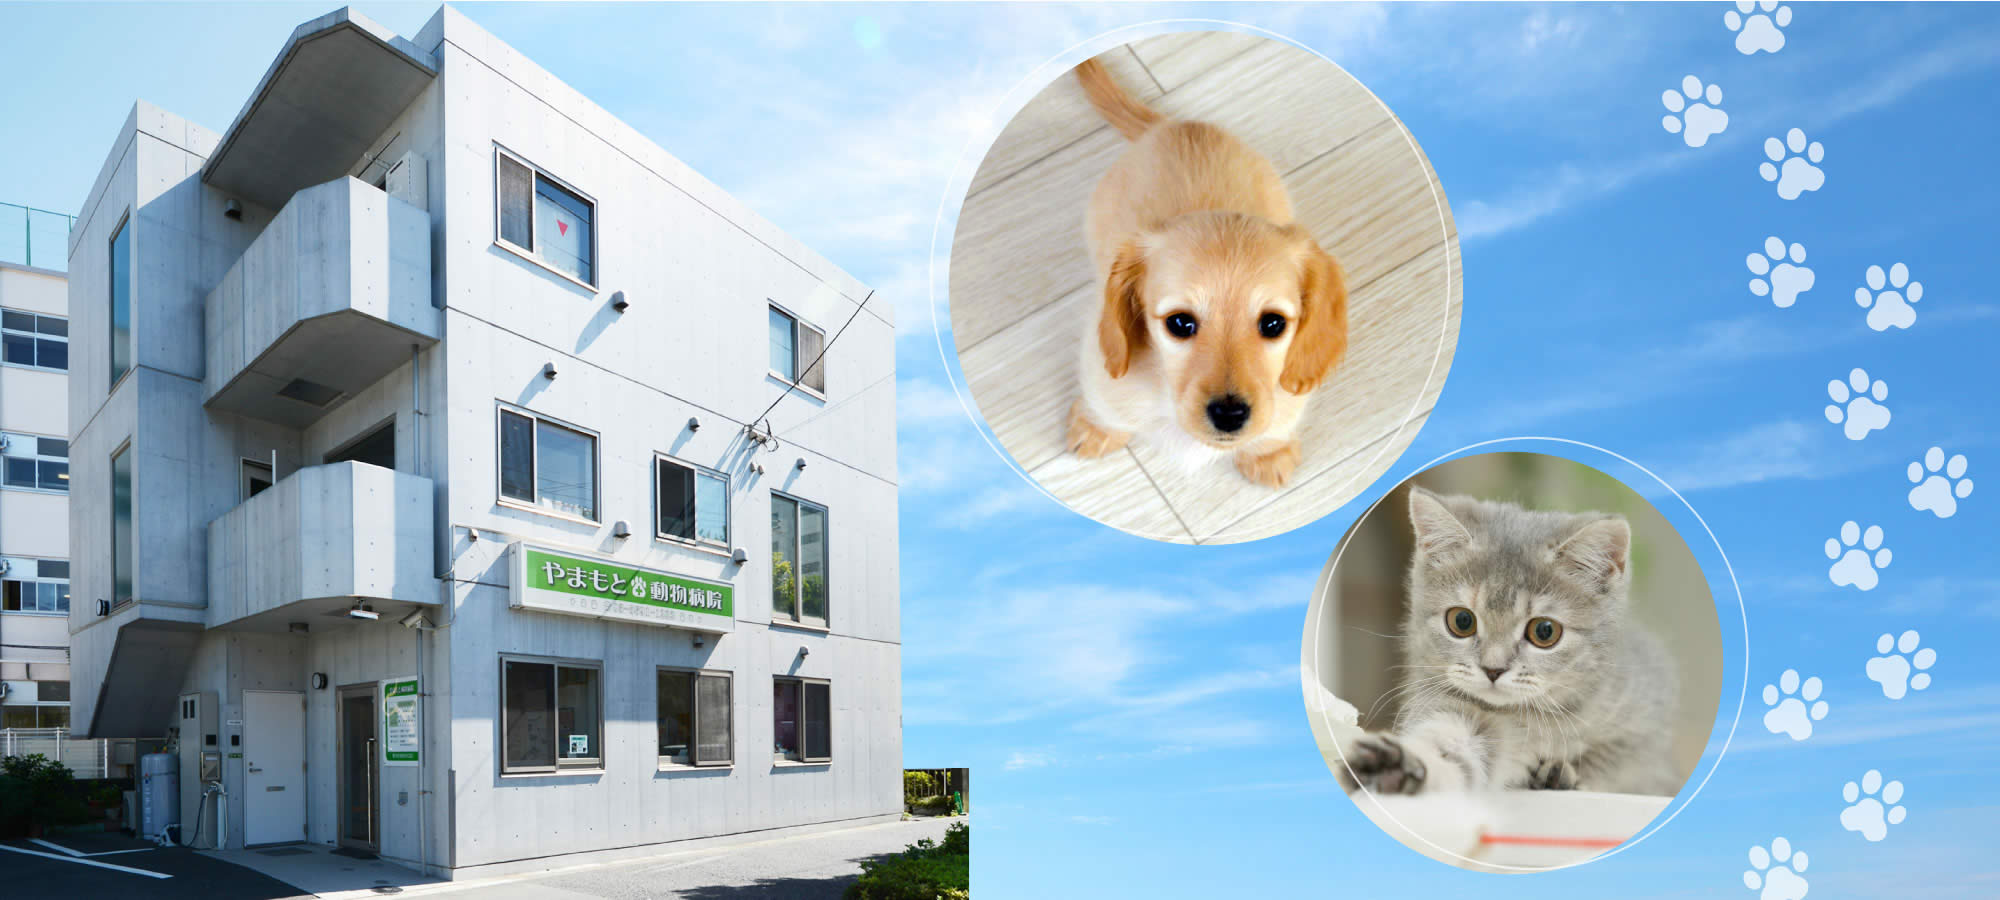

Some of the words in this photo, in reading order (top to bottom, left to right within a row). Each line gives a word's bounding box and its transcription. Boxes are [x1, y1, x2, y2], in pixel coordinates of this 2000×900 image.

[541, 561, 628, 595] やまもと
[650, 580, 723, 610] 動物病院
